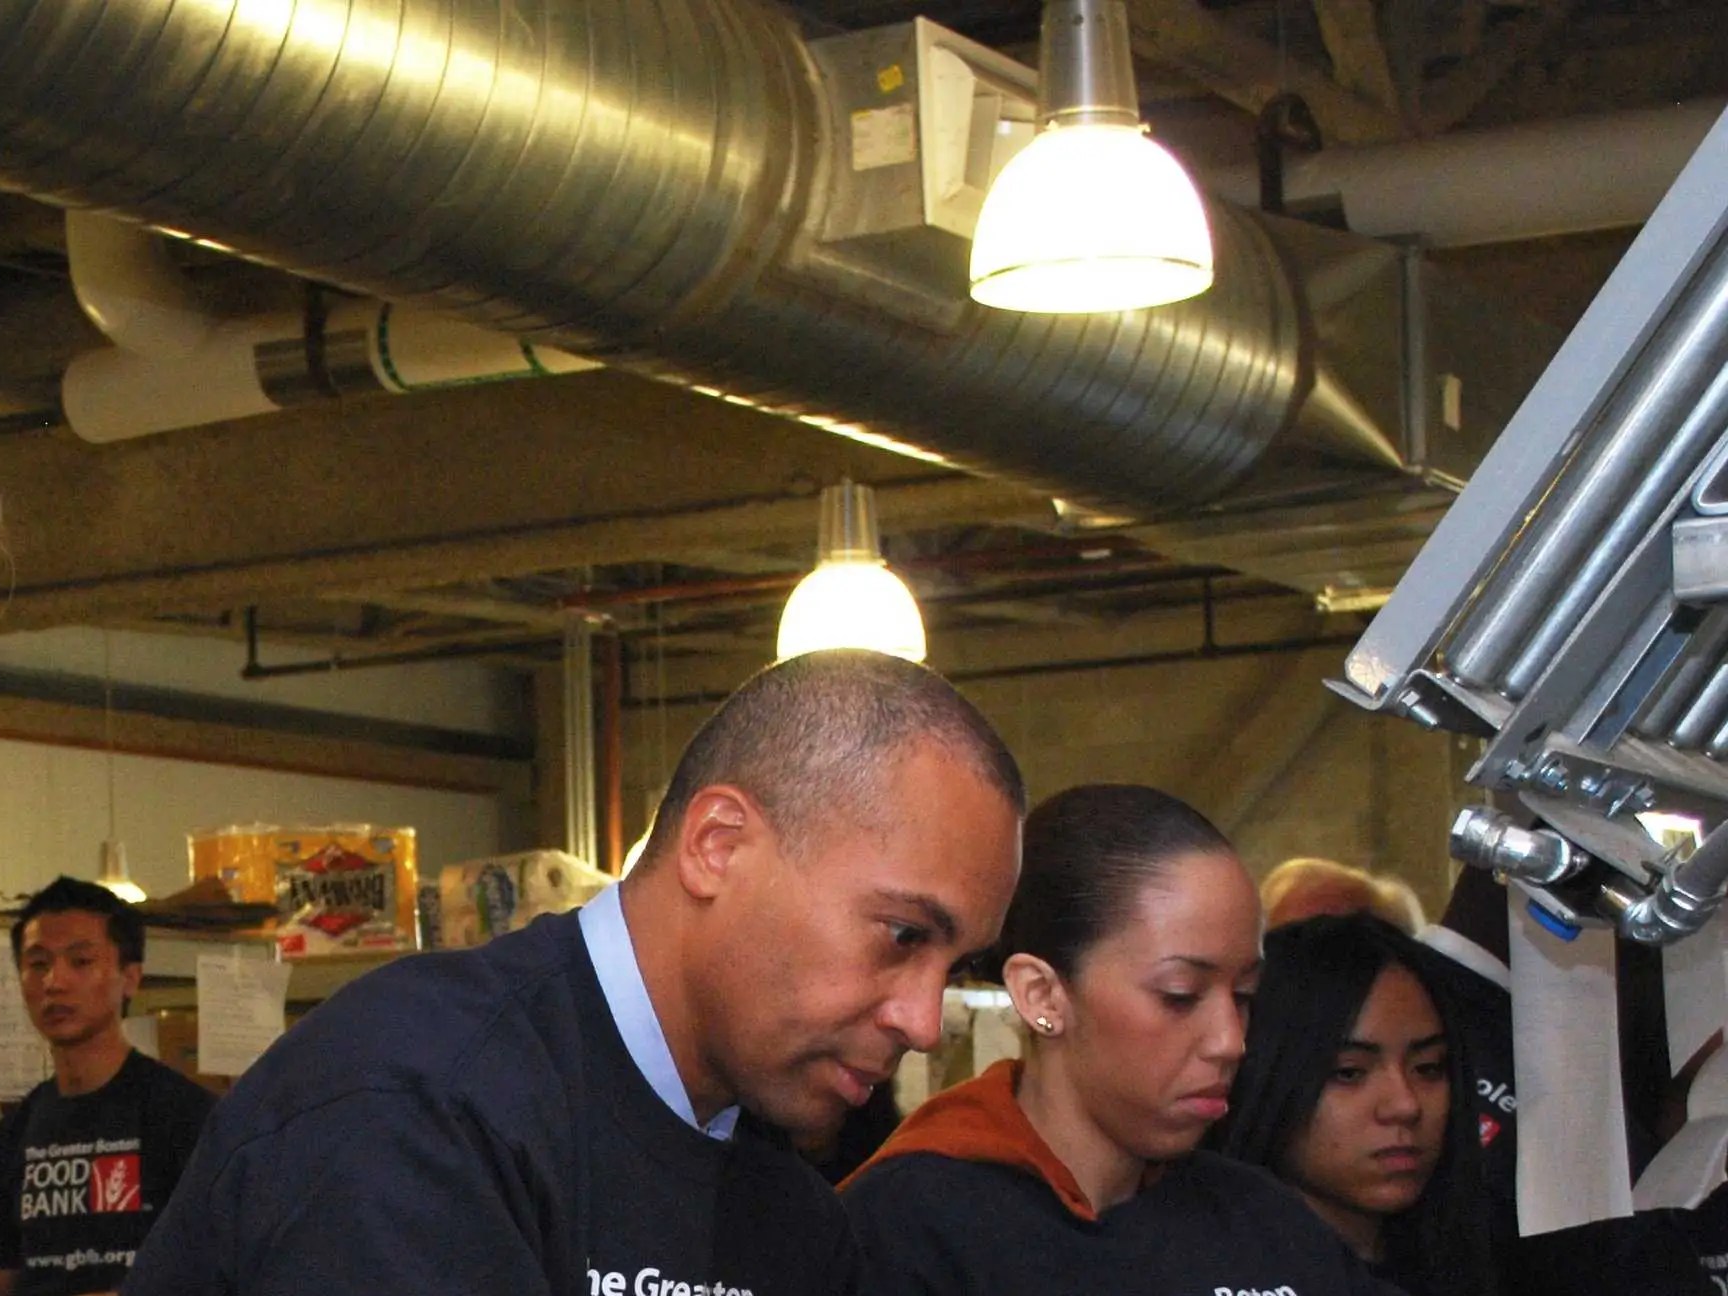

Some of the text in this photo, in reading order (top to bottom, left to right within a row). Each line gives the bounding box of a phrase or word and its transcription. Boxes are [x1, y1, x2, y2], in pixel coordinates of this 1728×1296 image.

[25, 1137, 140, 1161] The Greater Boston
[23, 1158, 91, 1191] FOOD
[21, 1188, 88, 1221] BANK
